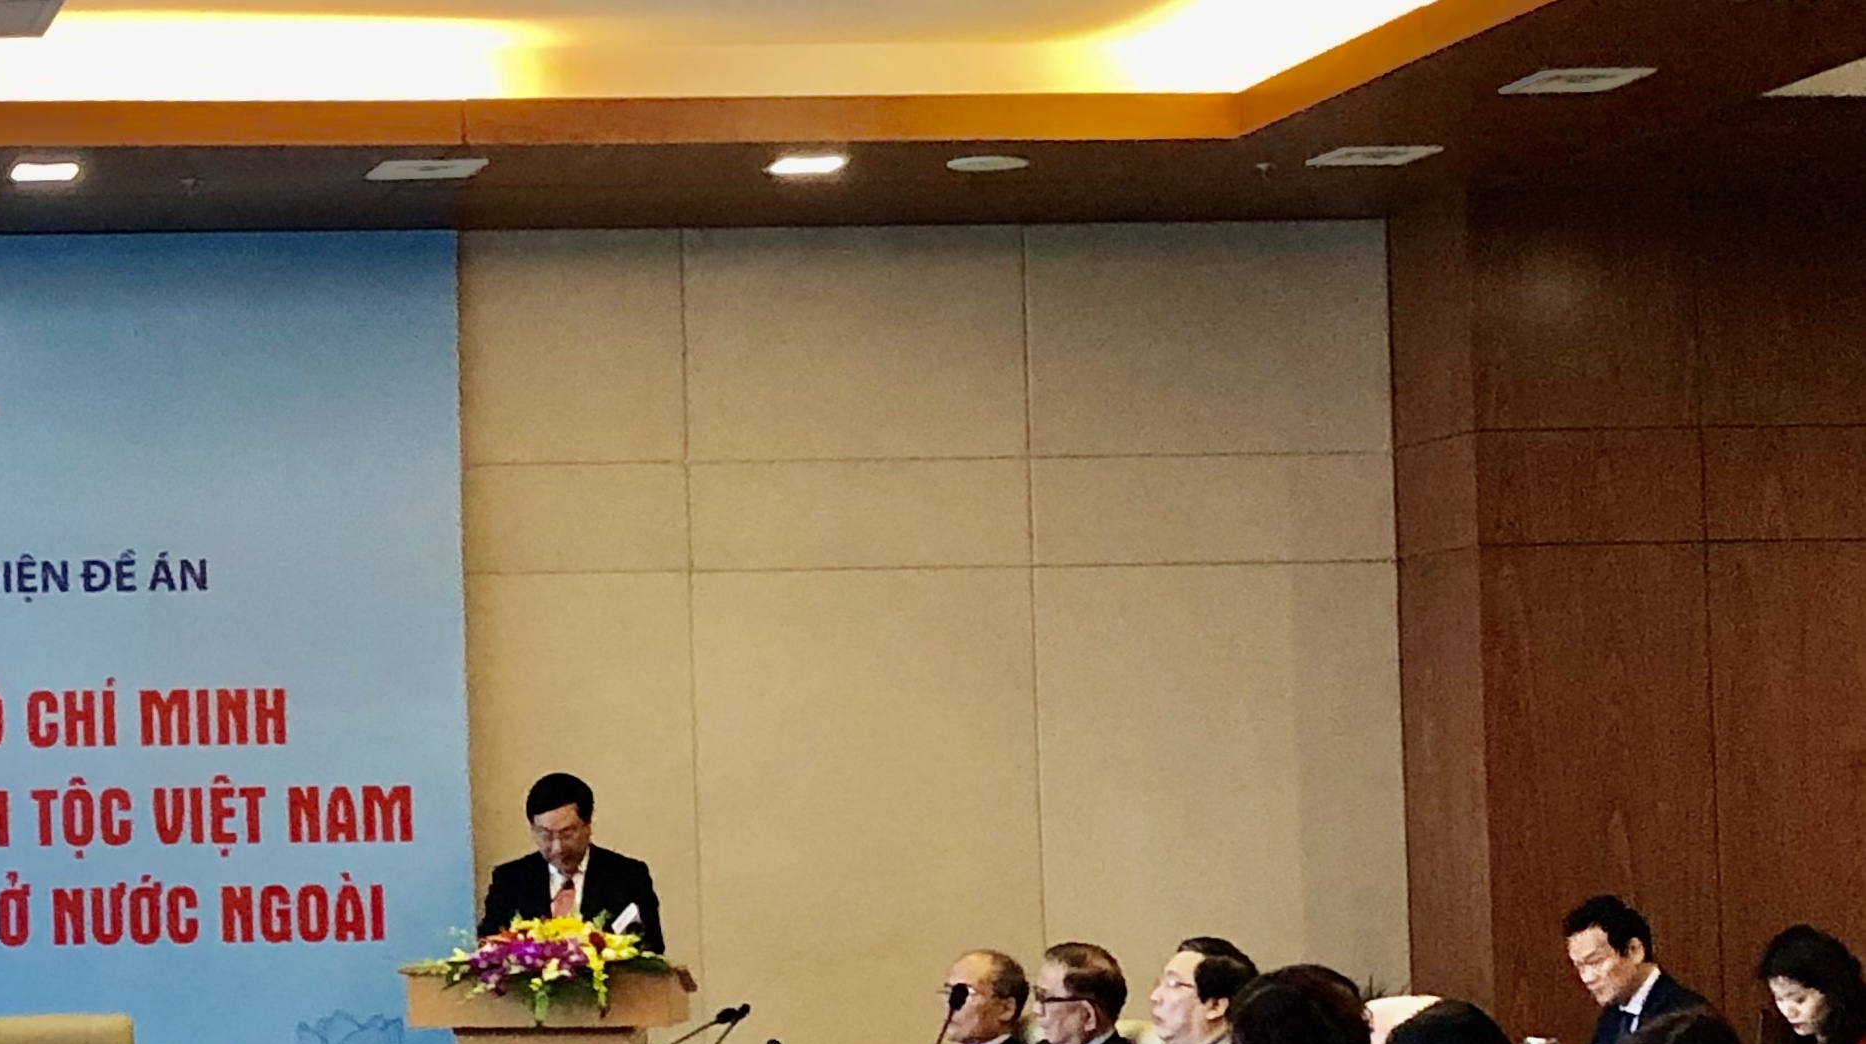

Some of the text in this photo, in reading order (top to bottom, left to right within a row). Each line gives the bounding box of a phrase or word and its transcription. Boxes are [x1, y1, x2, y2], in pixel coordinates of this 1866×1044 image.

[80, 549, 138, 593] ĐỀ
[148, 550, 209, 592] ÁN
[26, 676, 117, 748] CHÍ
[138, 687, 287, 746] MINH
[31, 776, 133, 859] TỘC
[152, 774, 267, 857] VIỆT
[287, 785, 414, 843] NAM
[51, 873, 200, 946] NƯỚC
[221, 872, 386, 944] NGOÀI
